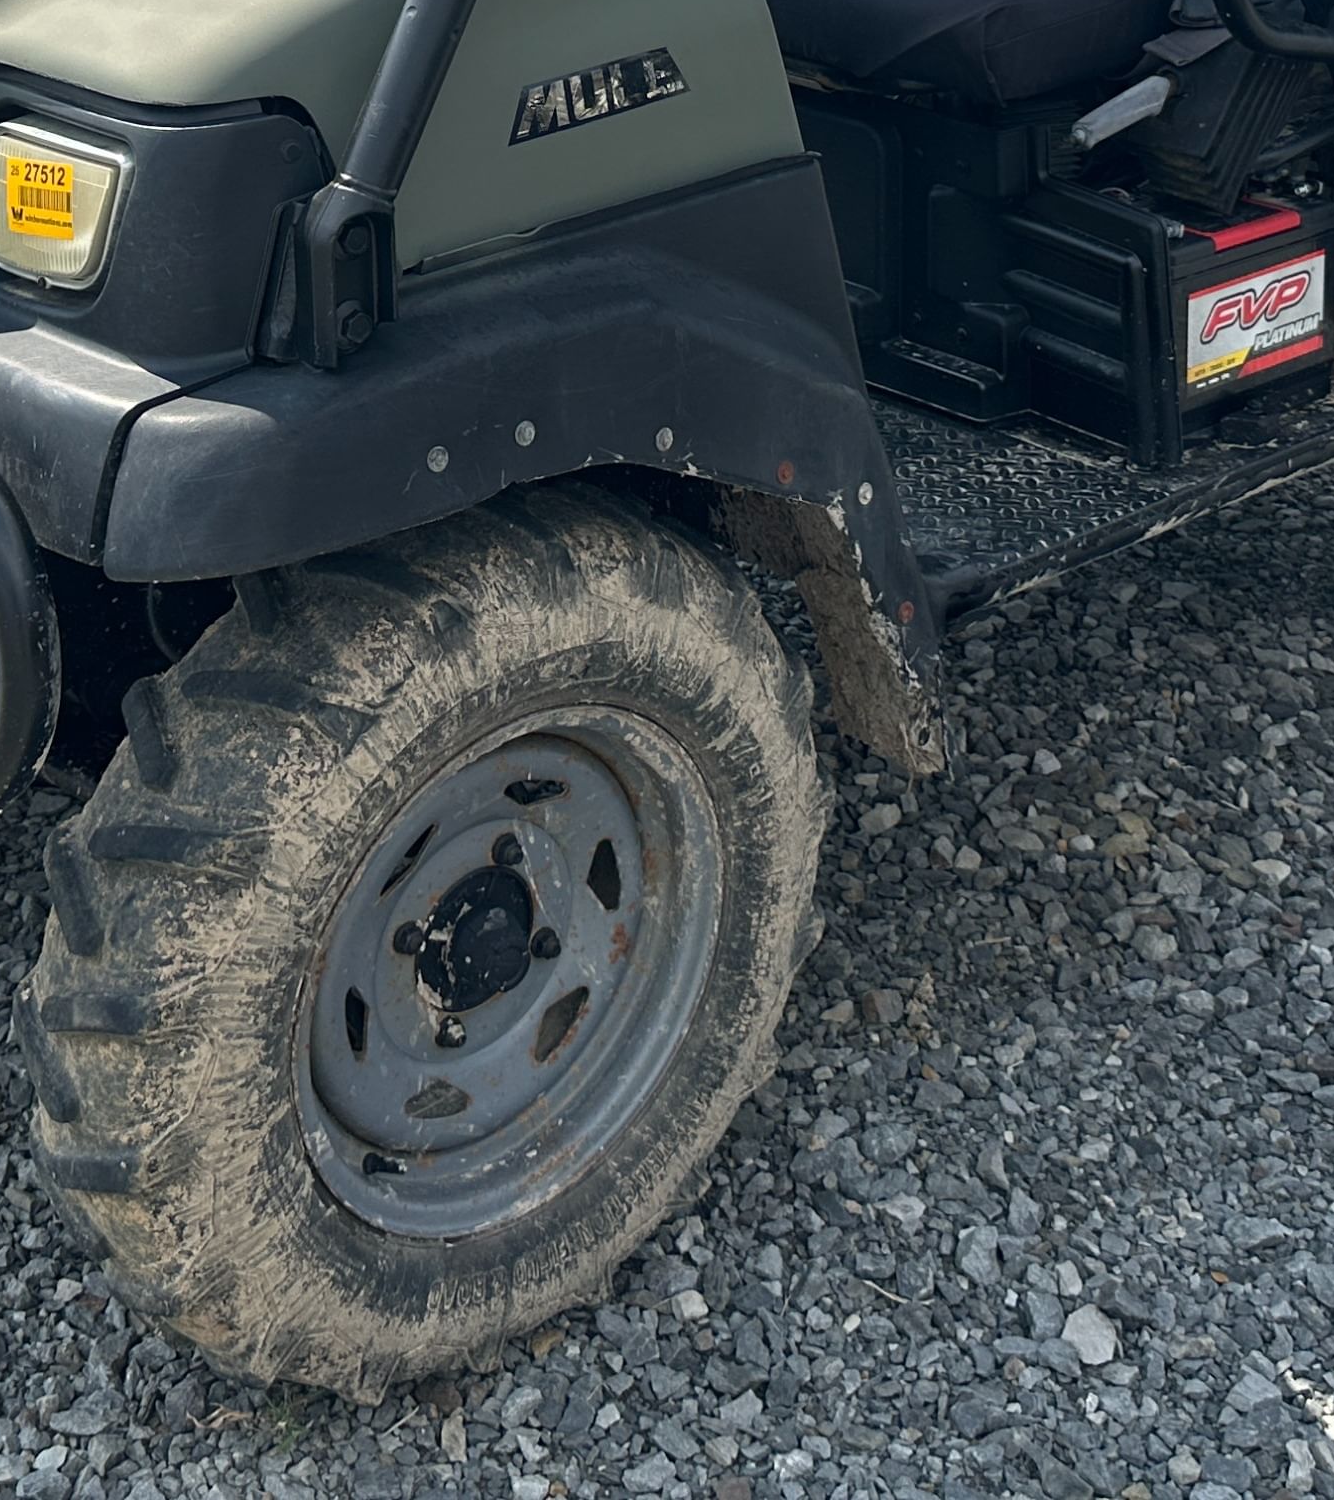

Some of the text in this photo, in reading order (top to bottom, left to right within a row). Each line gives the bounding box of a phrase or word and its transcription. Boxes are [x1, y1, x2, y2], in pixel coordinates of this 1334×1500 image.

[516, 54, 686, 137] MULE
[10, 162, 66, 187] 25 27512
[1200, 269, 1312, 345] FVP
[1253, 312, 1320, 352] PLATINUM
